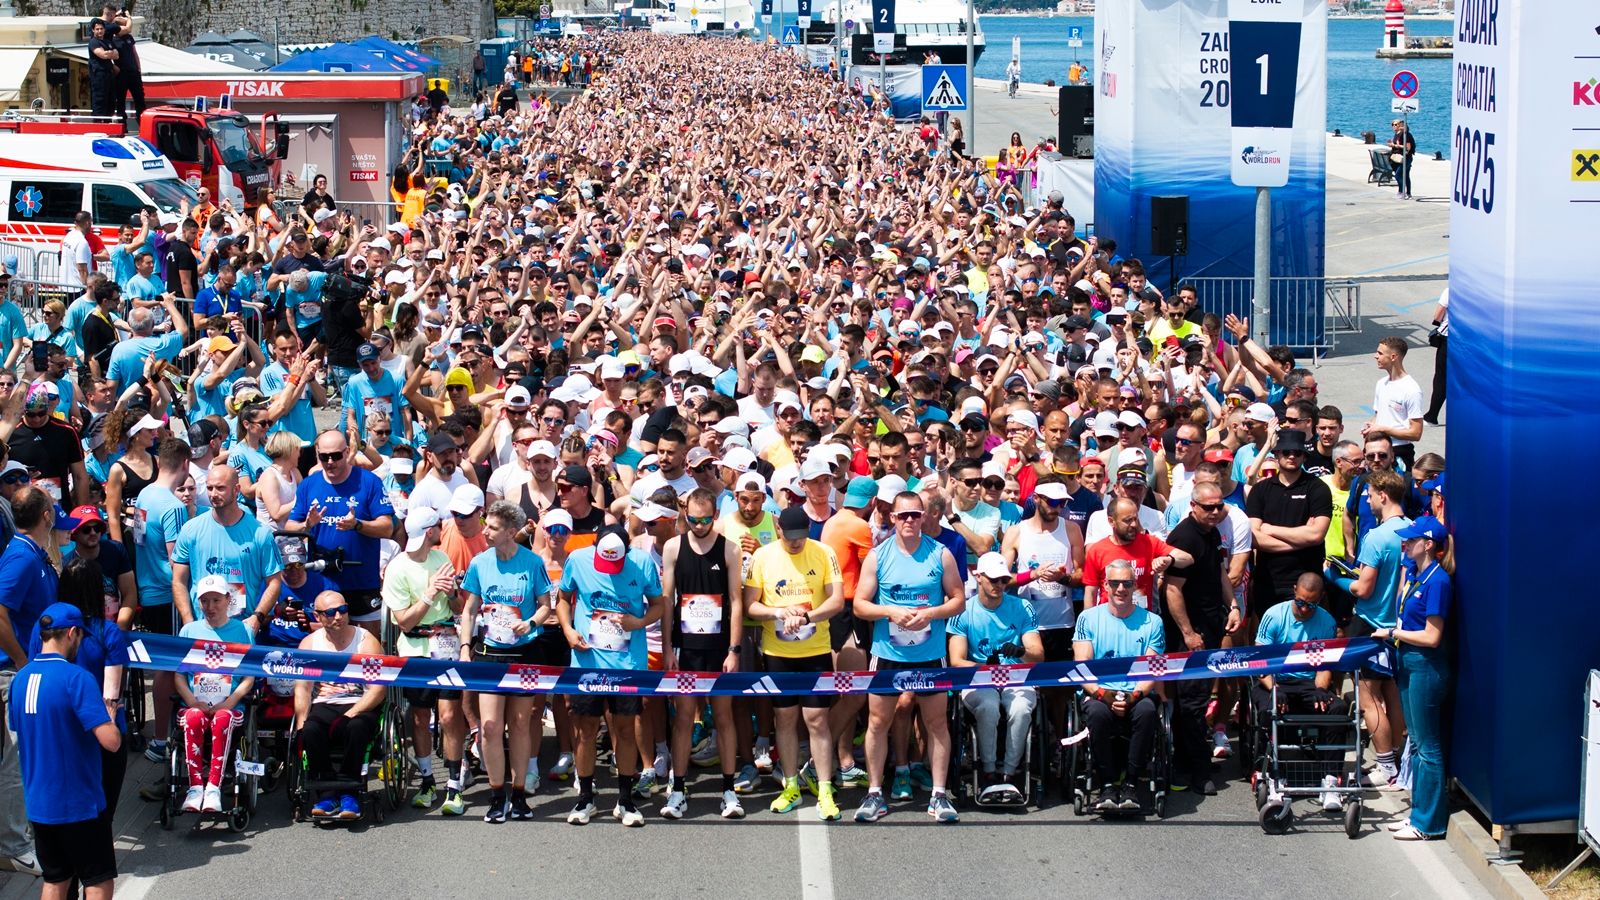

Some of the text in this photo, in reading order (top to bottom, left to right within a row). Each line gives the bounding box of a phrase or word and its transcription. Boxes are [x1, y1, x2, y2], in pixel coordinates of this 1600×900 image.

[802, 1, 807, 10] 3
[880, 9, 887, 23] 2
[1459, 0, 1498, 46] ZADAR
[1256, 54, 1268, 95] 1
[226, 81, 285, 96] TISAK
[1200, 80, 1230, 107] 20
[1457, 62, 1496, 112] CROATIA
[352, 153, 376, 161] SVAŠTA
[352, 172, 376, 180] TISAK
[1454, 125, 1495, 214] 2025
